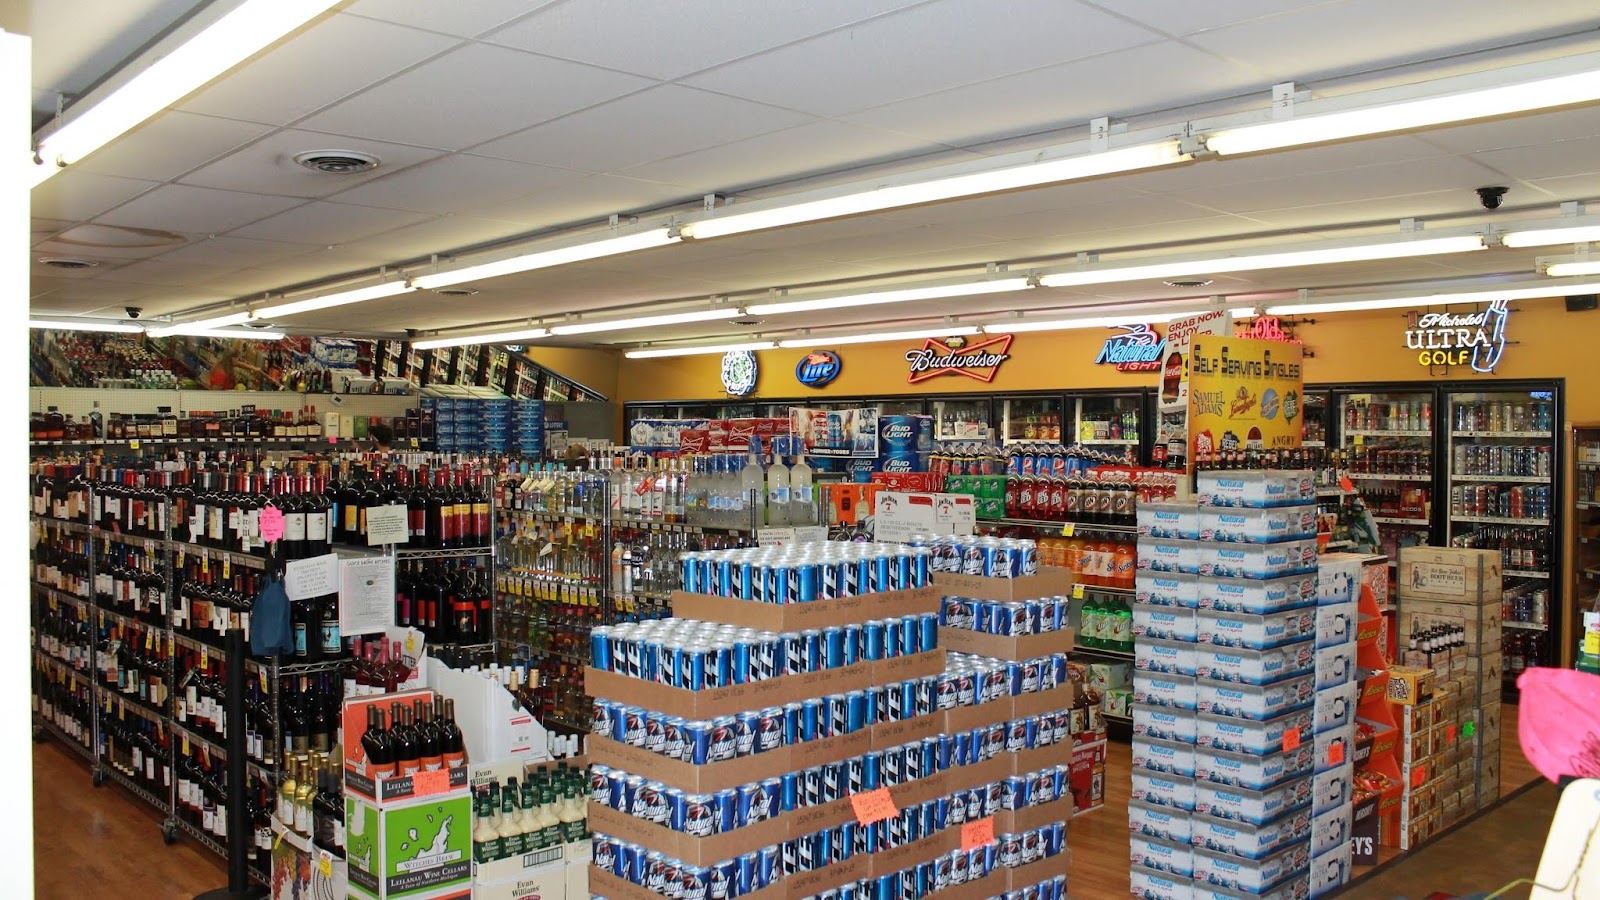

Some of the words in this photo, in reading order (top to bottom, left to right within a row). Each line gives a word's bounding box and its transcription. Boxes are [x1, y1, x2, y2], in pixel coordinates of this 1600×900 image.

[1169, 317, 1195, 332] GRAB
[1198, 310, 1224, 325] NOW.
[1419, 313, 1484, 328] Michelob
[1256, 316, 1278, 339] Old
[1169, 326, 1199, 342] ENJOY
[1405, 328, 1491, 349] ULTRA
[1096, 338, 1166, 364] Natural
[906, 349, 1008, 371] Budweiser
[1194, 344, 1218, 373] SELF
[1222, 346, 1261, 376] SERVING
[1264, 350, 1299, 378] SINGLES
[1419, 351, 1468, 366] GOLF
[1117, 362, 1161, 371] LIGHT
[1193, 390, 1225, 404] SAMUEL
[1195, 404, 1222, 417] ADAMS
[1272, 436, 1295, 447] ANGRY
[1217, 480, 1244, 488] Natural
[1154, 511, 1180, 520] Natural
[1218, 514, 1246, 524] Natural
[1154, 545, 1180, 554] Natural
[1218, 550, 1246, 559] Natural
[1153, 579, 1179, 588] Natural
[1217, 584, 1244, 594] Natural
[1150, 612, 1176, 622] Natural
[1216, 619, 1243, 629] Natural
[1152, 646, 1177, 656] Natural
[1214, 654, 1241, 664] Natural
[1151, 680, 1177, 690] Natural
[1216, 688, 1243, 699] Natural
[1151, 712, 1177, 722] Natural
[1216, 723, 1244, 734] Natural
[1150, 745, 1175, 756] Natural
[1214, 757, 1242, 769] Natural
[475, 770, 492, 778] Evan
[387, 781, 413, 791] LEELANA
[470, 776, 498, 786] Williams
[1149, 778, 1175, 789] Natural
[1214, 791, 1242, 803] Natural
[1145, 810, 1171, 822] Natural
[684, 815, 714, 833] Natural
[1209, 824, 1238, 837] Natural
[1147, 843, 1172, 854] Natural
[404, 859, 433, 869] WITCHES
[436, 855, 454, 863] BREW
[1212, 858, 1241, 871] Natural
[391, 876, 422, 887] LEELANAU
[424, 870, 440, 879] WINE
[442, 865, 467, 876] CELLARS
[440, 874, 459, 882] Michigan
[517, 880, 534, 889] Evan
[1148, 876, 1174, 888] Natural
[512, 886, 541, 898] Williams
